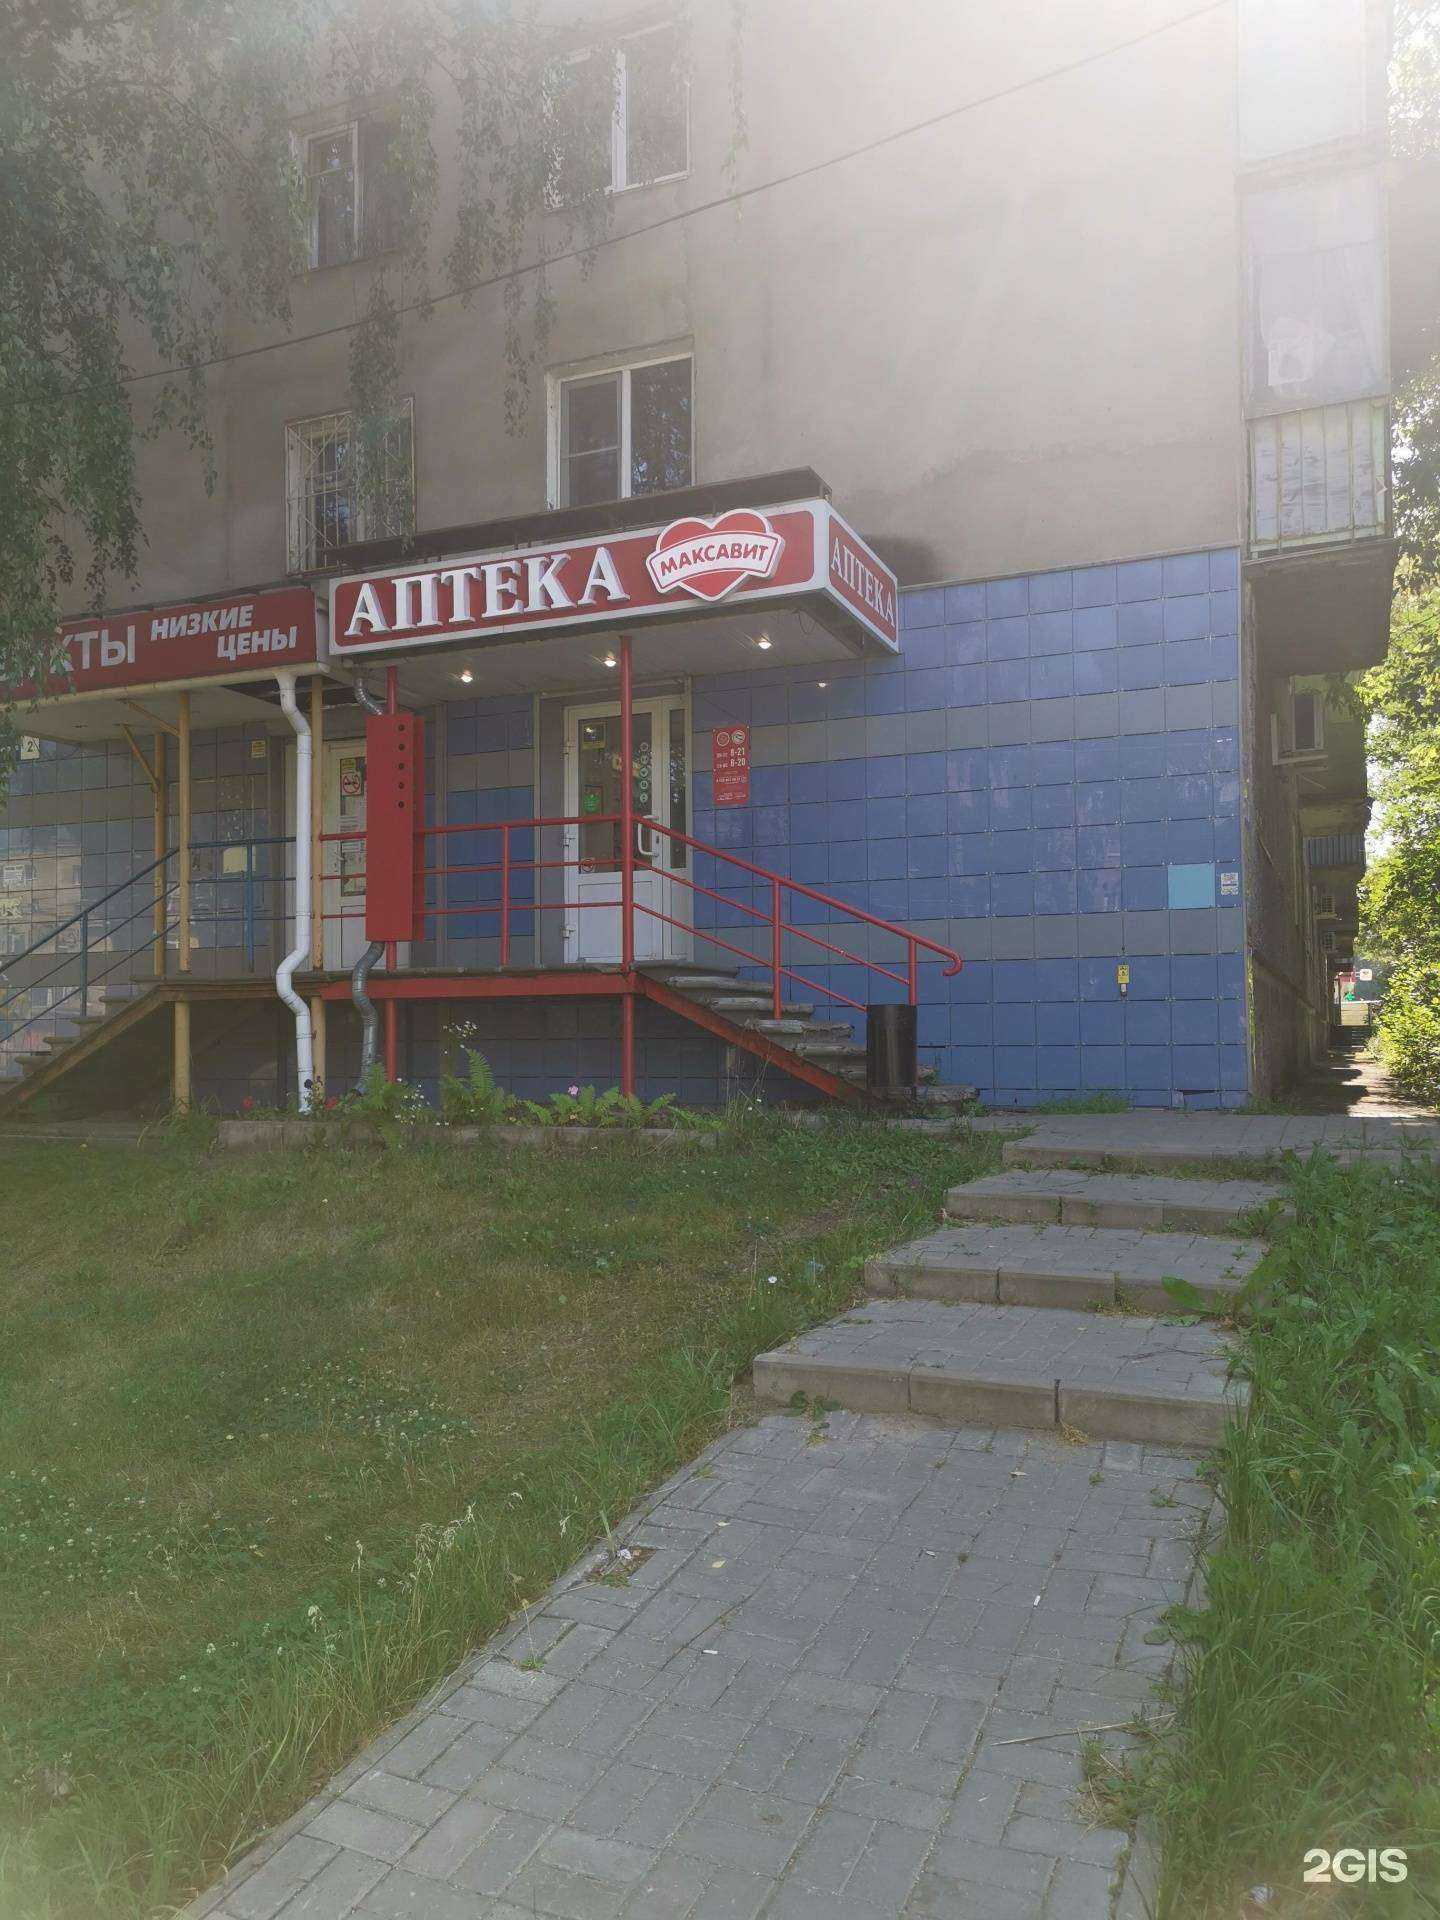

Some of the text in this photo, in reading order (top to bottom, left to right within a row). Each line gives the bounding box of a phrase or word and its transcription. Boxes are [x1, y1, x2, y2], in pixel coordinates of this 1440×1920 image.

[660, 542, 769, 577] МАКСАВИТ
[343, 546, 631, 636] АПТЕКА
[830, 536, 896, 628] АПТЕКА
[150, 604, 254, 641] НИЗКИЕ
[216, 625, 298, 661] ЦЕНЫ
